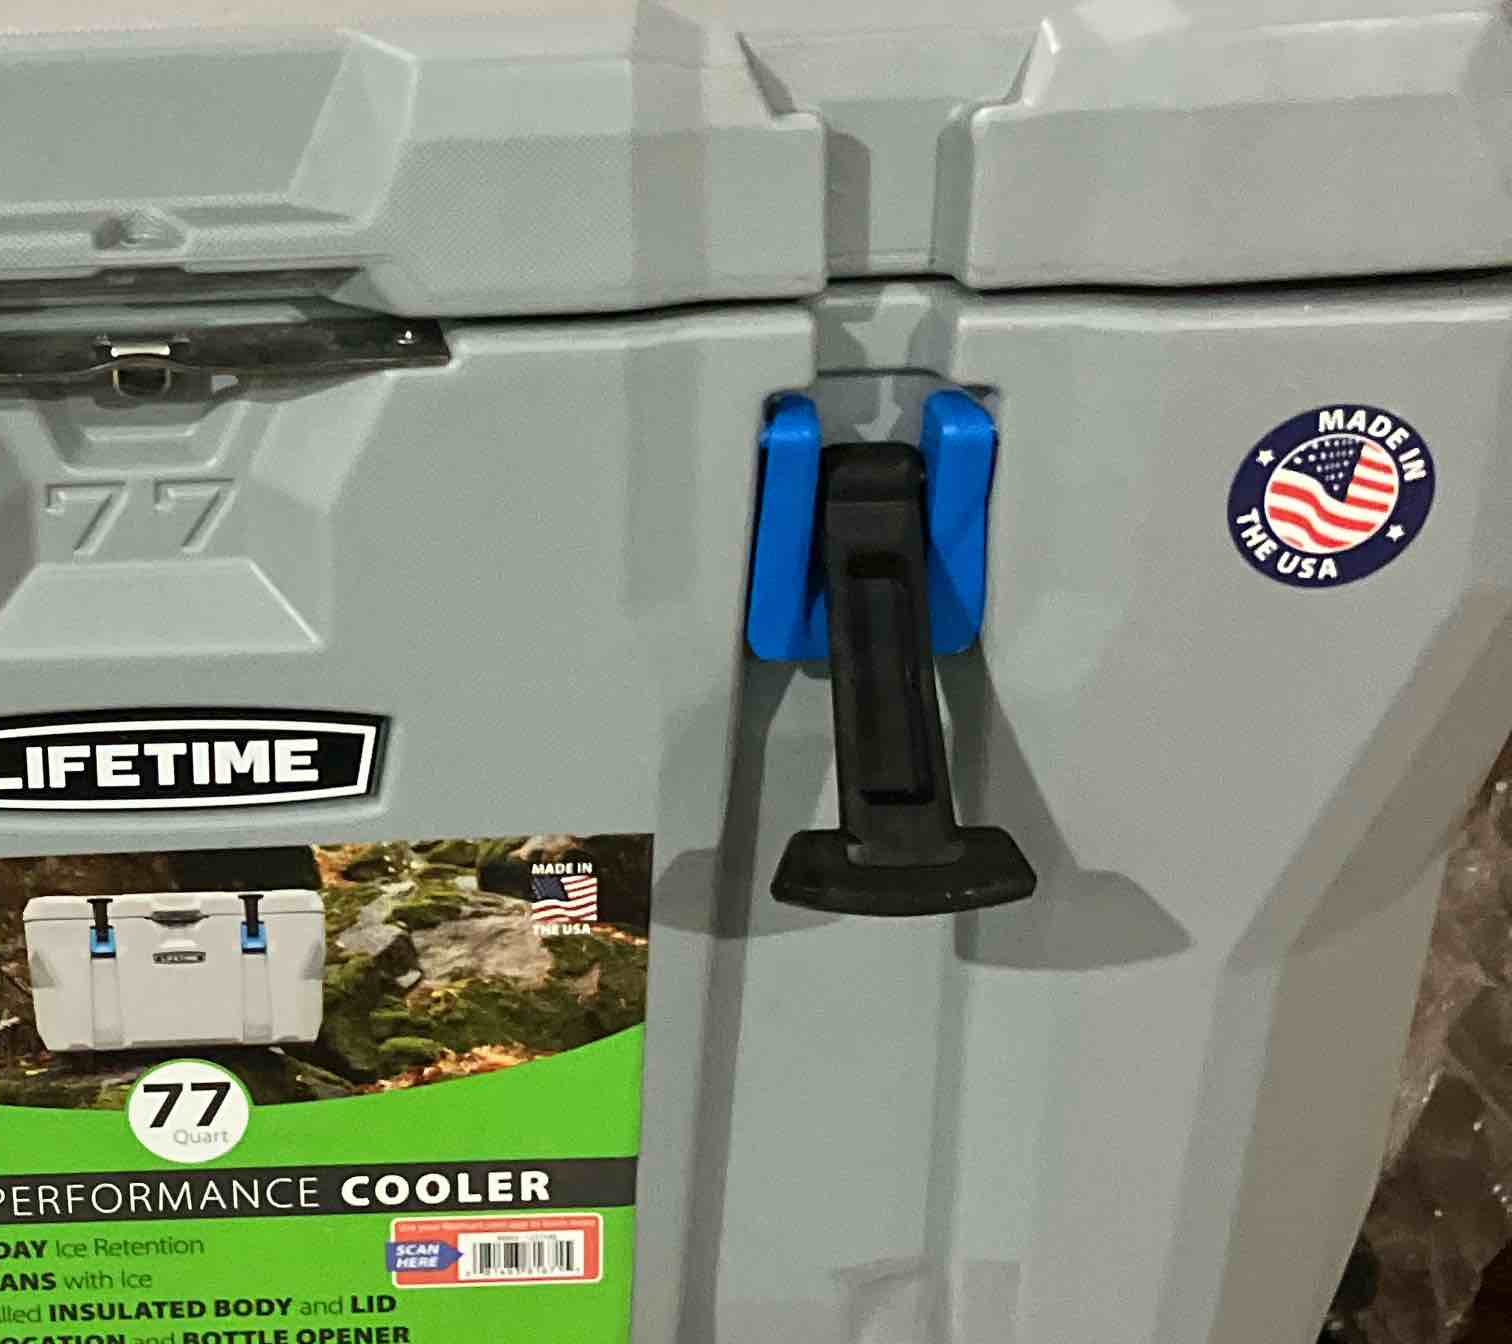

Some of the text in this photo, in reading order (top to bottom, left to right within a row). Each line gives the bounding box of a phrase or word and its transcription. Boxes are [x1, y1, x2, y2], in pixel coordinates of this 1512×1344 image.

[1317, 408, 1427, 483] MADE IN
[45, 477, 240, 557] 77
[1236, 507, 1339, 580] THE USA
[531, 862, 593, 875] MADE IN
[532, 922, 591, 935] THE USA
[143, 1081, 232, 1129] 77
[173, 1128, 231, 1146] Quart
[341, 1170, 551, 1207] COOLER
[56, 1239, 90, 1258] Ice
[94, 1235, 206, 1258] Retention
[394, 1243, 440, 1257] SCAN
[395, 1256, 439, 1270] HERE
[63, 1269, 117, 1290] with
[121, 1269, 154, 1289] Ice
[48, 1299, 207, 1323] INSULATED
[214, 1296, 293, 1319] BODY
[299, 1296, 344, 1317] and
[351, 1294, 397, 1315] LID
